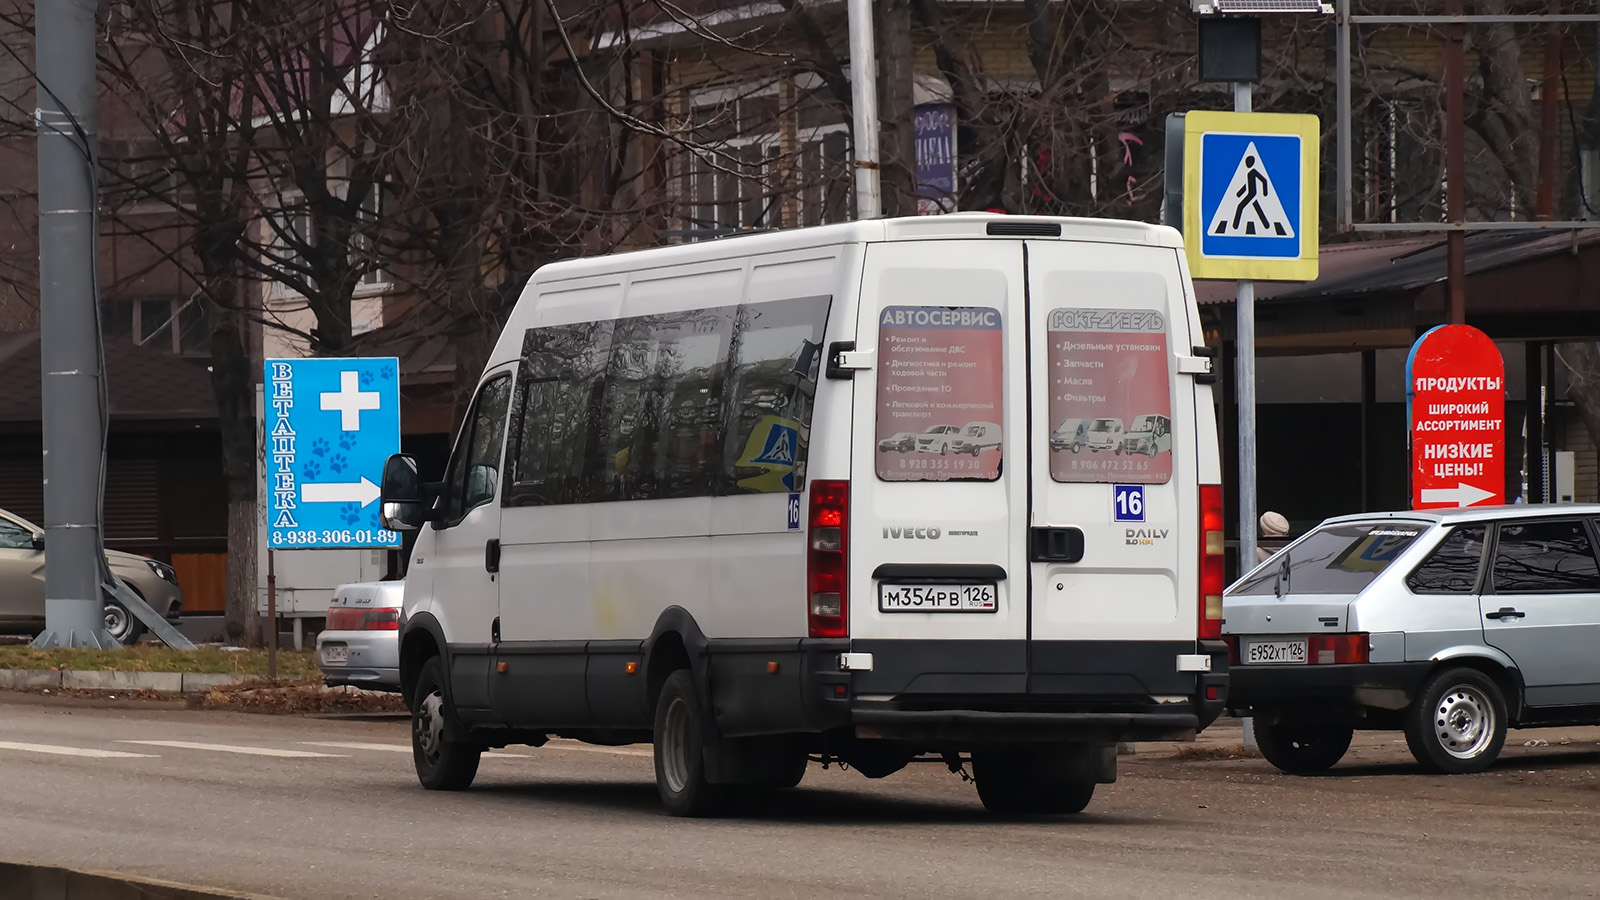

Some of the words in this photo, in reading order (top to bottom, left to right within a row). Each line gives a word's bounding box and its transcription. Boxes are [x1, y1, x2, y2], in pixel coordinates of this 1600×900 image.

[882, 310, 996, 326] АВТОСЕРВИС
[1053, 310, 1164, 330] РОКТ-ДИЗЕЛЬ
[891, 335, 919, 343] Ремонт
[891, 345, 946, 354] обслуживание
[949, 346, 966, 354] ДВС
[1063, 341, 1113, 352] Дизельные
[1115, 343, 1161, 352] установки
[891, 359, 940, 368] Диагностика
[1063, 359, 1104, 369] Запчасти
[891, 369, 924, 377] ходовой
[1064, 377, 1093, 385] Масла
[1416, 377, 1501, 393] ПРОДУКТЫ
[891, 384, 939, 394] Проведение
[940, 385, 952, 393] ТО
[1063, 393, 1106, 404] Фильтры
[891, 401, 929, 409] Легковой
[936, 402, 994, 410] коммерческий
[1428, 401, 1489, 415] ШИРОКИЙ
[891, 411, 932, 419] транспорт
[1416, 419, 1502, 432] АССОРТИМЕНТ
[272, 362, 298, 527] ВЕТАПТЕКА
[1424, 443, 1494, 459] НИЗКИЕ
[899, 459, 906, 468] 8
[908, 459, 928, 469] 928
[930, 459, 949, 469] 355
[953, 460, 965, 469] 19
[967, 460, 980, 470] 30
[1071, 460, 1078, 469] 8
[1080, 460, 1098, 470] 906
[1101, 461, 1119, 470] 472
[1122, 461, 1134, 470] 52
[1136, 461, 1148, 470] 65
[1433, 463, 1484, 479] ЦЕНЫ!
[1115, 490, 1143, 515] 16
[788, 499, 798, 523] 16
[272, 530, 397, 545] 8-938-306-01-89
[882, 525, 941, 540] IVECO
[1125, 528, 1169, 539] DAILY
[963, 587, 990, 602] 126
[1288, 643, 1302, 656] 126
